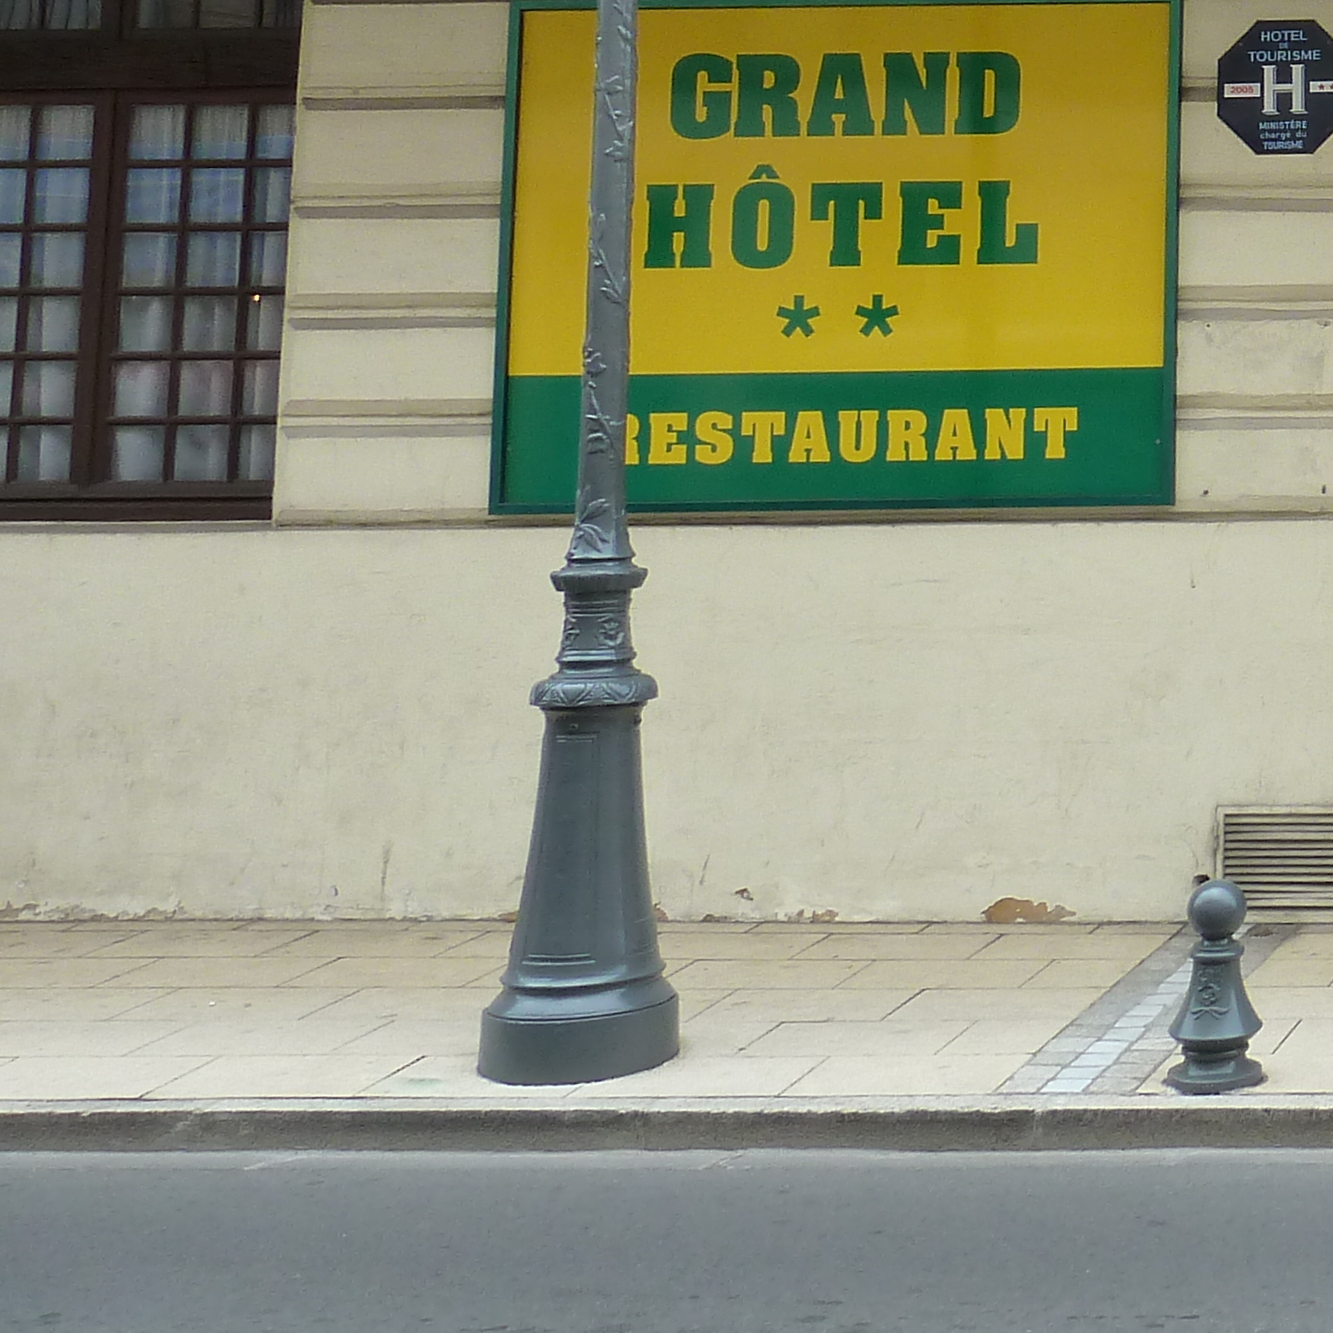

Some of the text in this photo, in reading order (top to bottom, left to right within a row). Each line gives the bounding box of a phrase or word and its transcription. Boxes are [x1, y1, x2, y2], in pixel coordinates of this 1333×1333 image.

[1261, 30, 1308, 42] HOTEL
[1248, 50, 1321, 62] TOURISME
[670, 51, 1022, 140] GRAND
[1261, 64, 1308, 115] H
[1296, 129, 1307, 138] du
[1262, 140, 1304, 150] TOURISME
[644, 164, 1039, 270] HÔTEL
